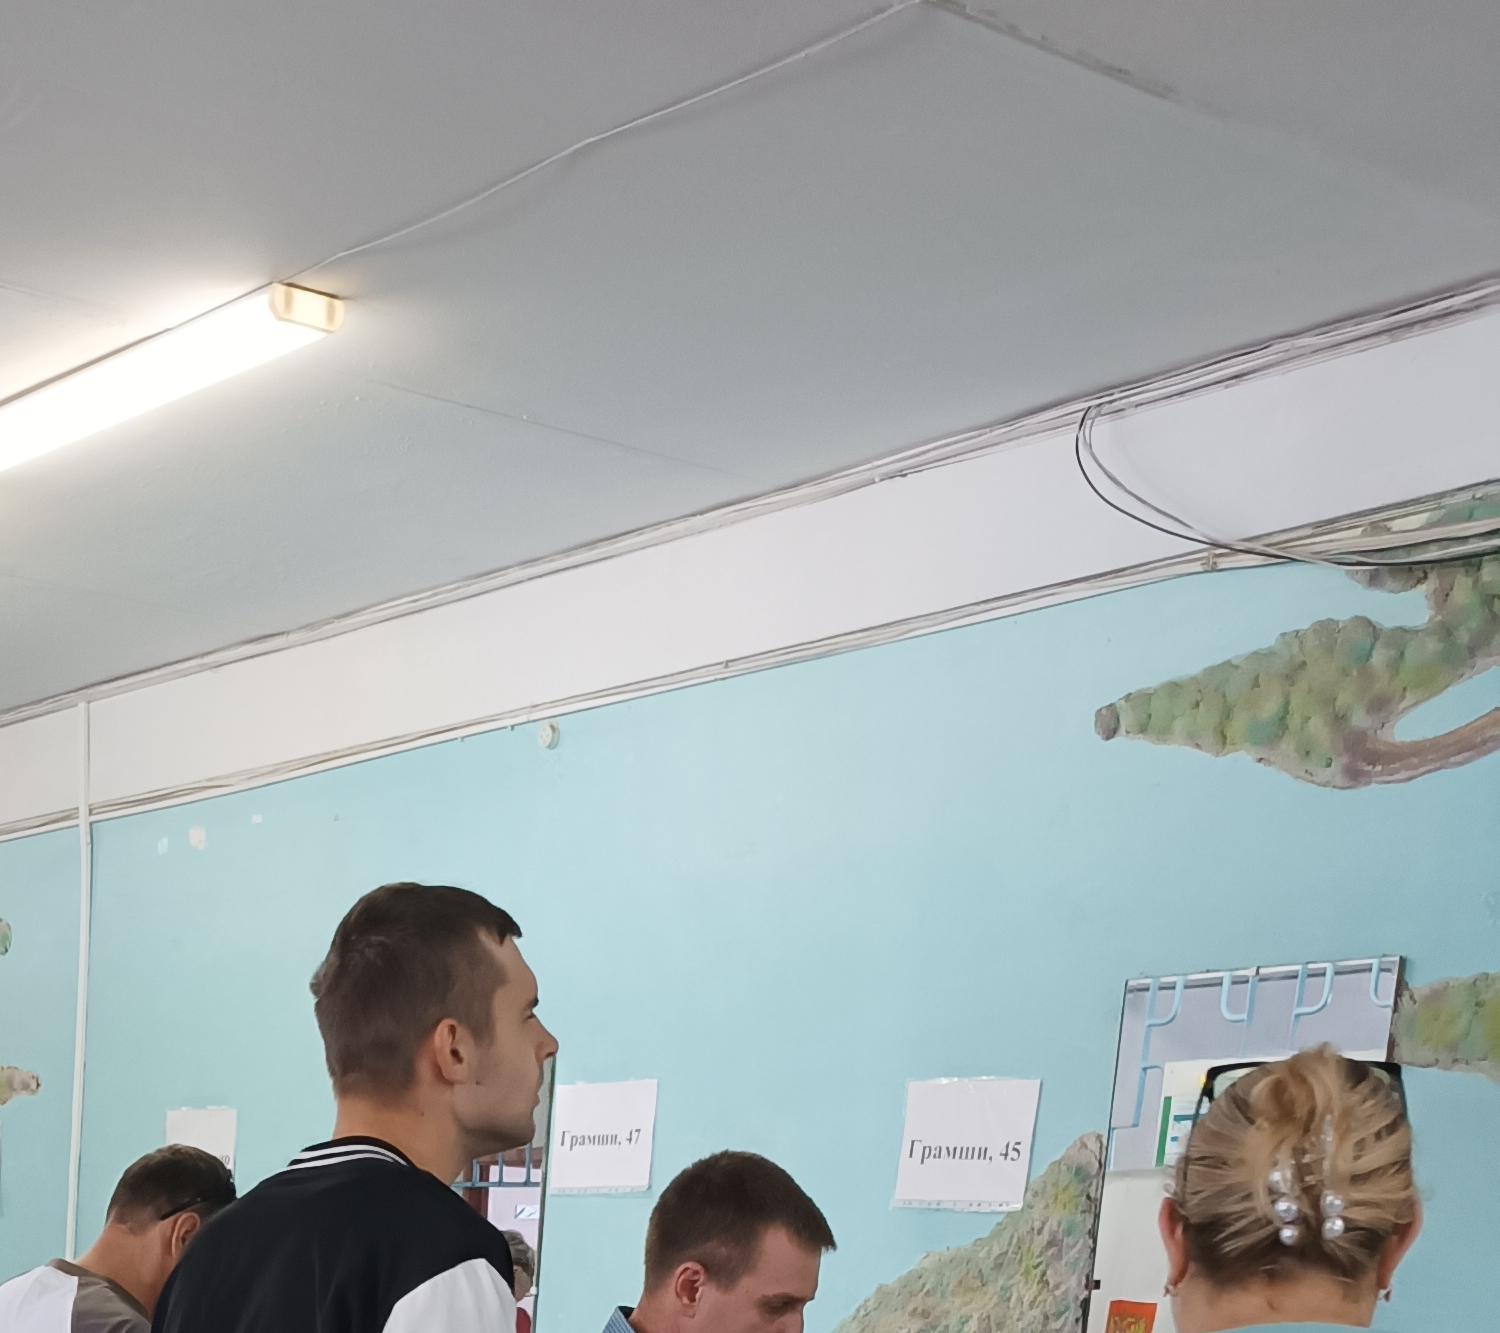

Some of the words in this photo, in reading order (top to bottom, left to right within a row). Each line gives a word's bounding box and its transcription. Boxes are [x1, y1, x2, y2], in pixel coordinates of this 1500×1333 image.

[558, 1130, 622, 1152] Грамши,
[625, 1128, 642, 1145] 47
[908, 1139, 993, 1165] Грамши,
[999, 1140, 1022, 1162] 45
